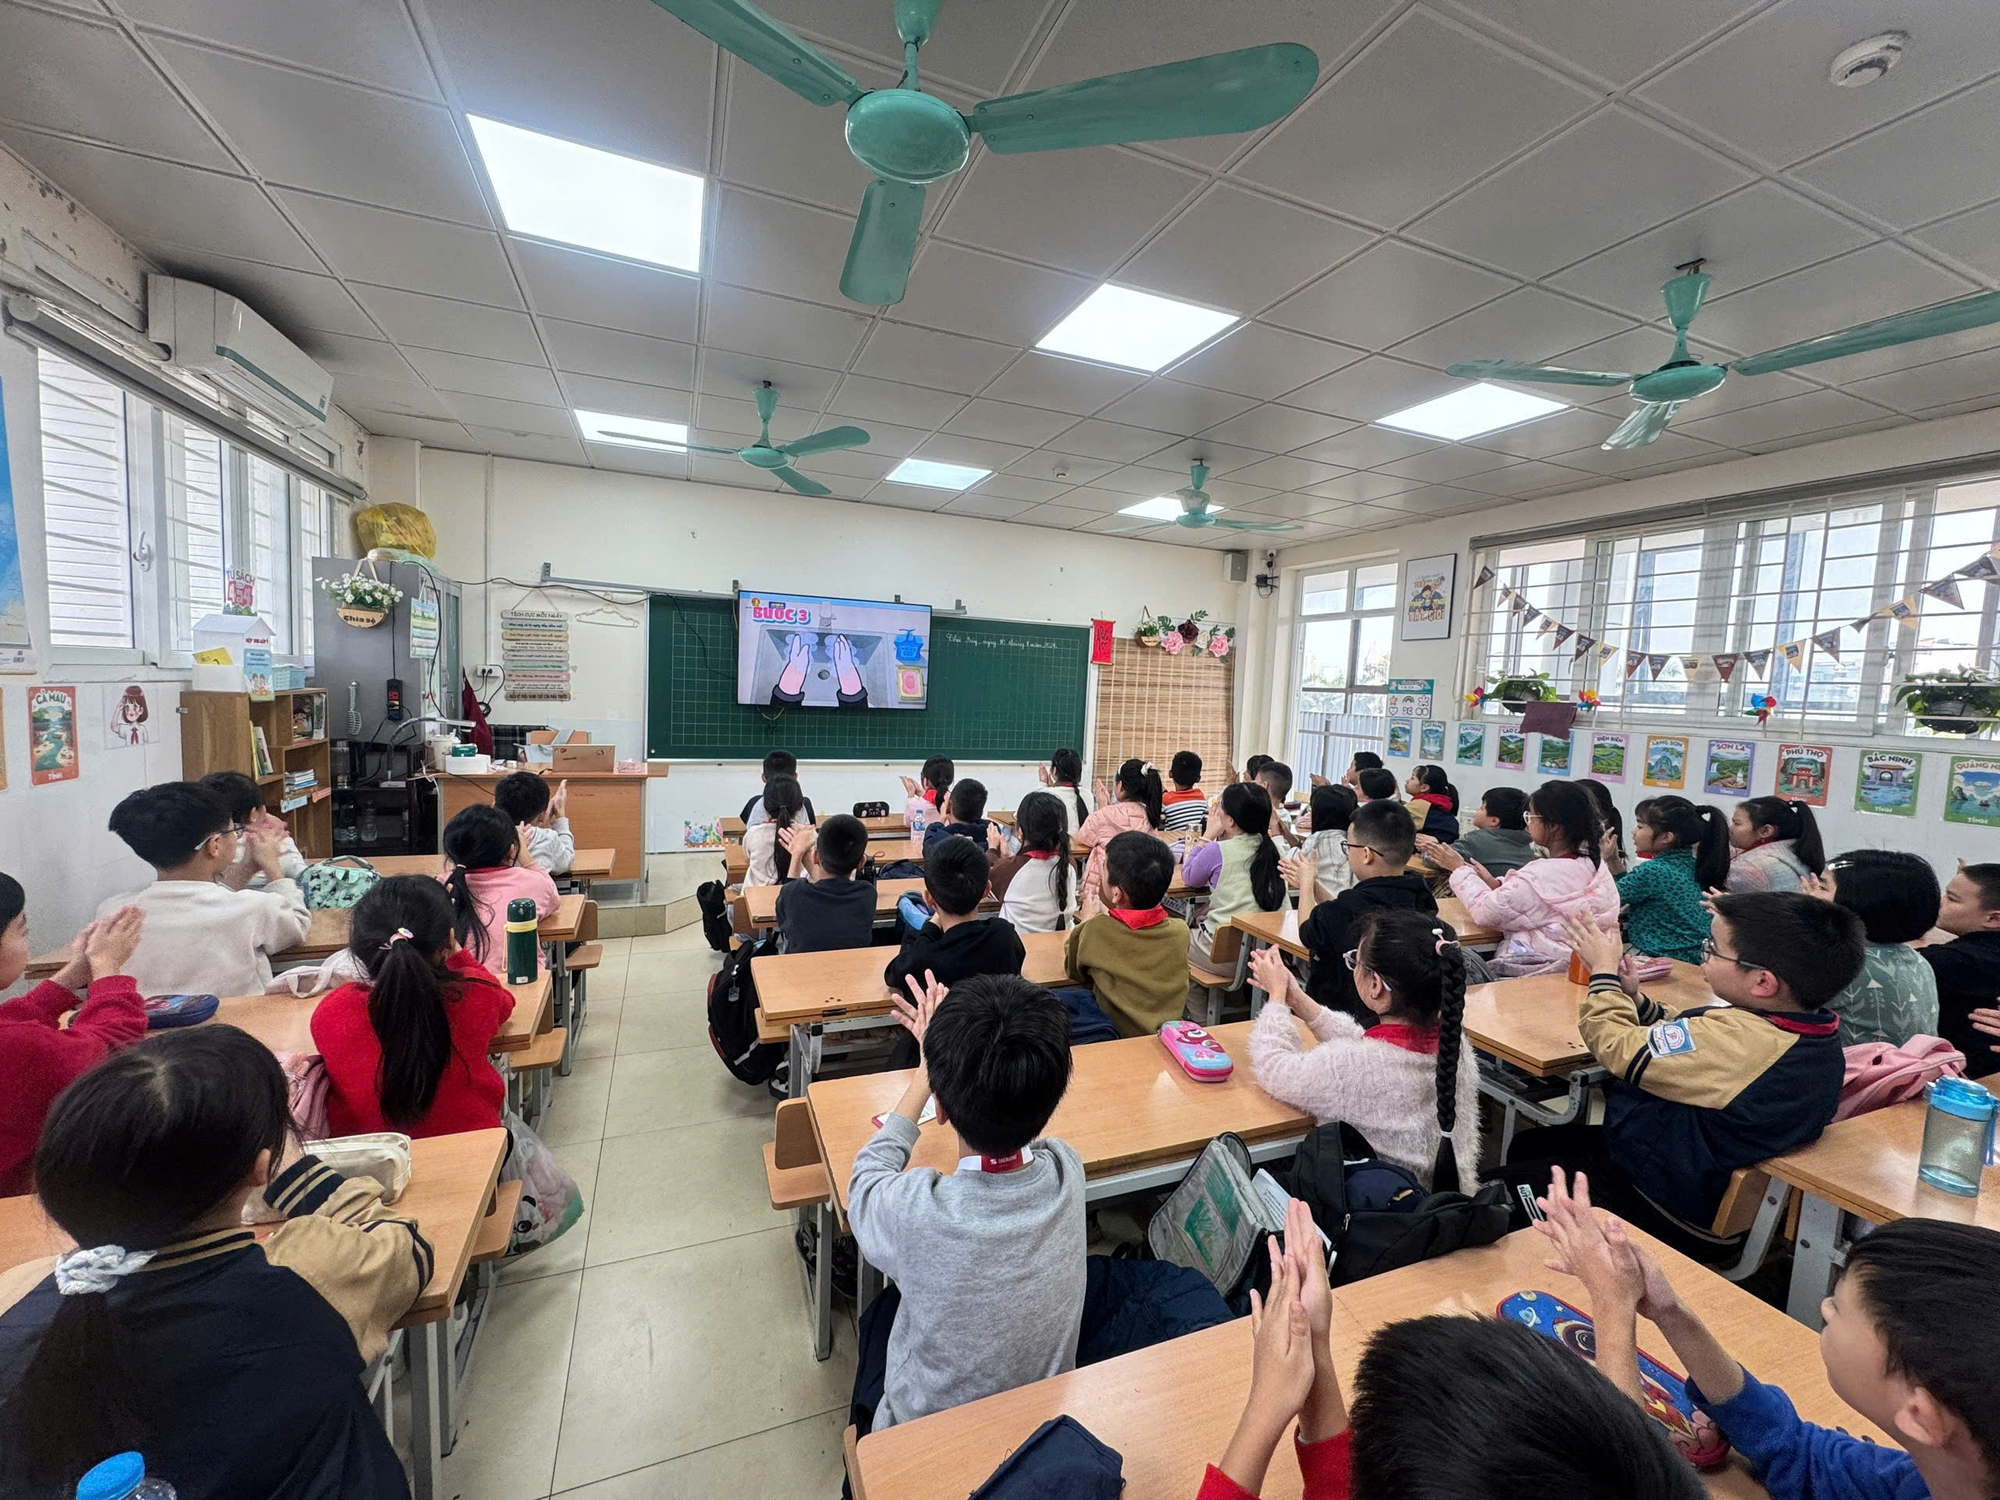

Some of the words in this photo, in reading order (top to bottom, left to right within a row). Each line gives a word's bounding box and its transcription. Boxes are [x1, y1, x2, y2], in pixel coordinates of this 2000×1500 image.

[343, 614, 365, 623] Chia
[798, 609, 808, 622] 3
[48, 693, 67, 704] MAU
[1735, 744, 1746, 752] LA
[1805, 748, 1825, 760] THỌ
[1888, 755, 1914, 766] NINH
